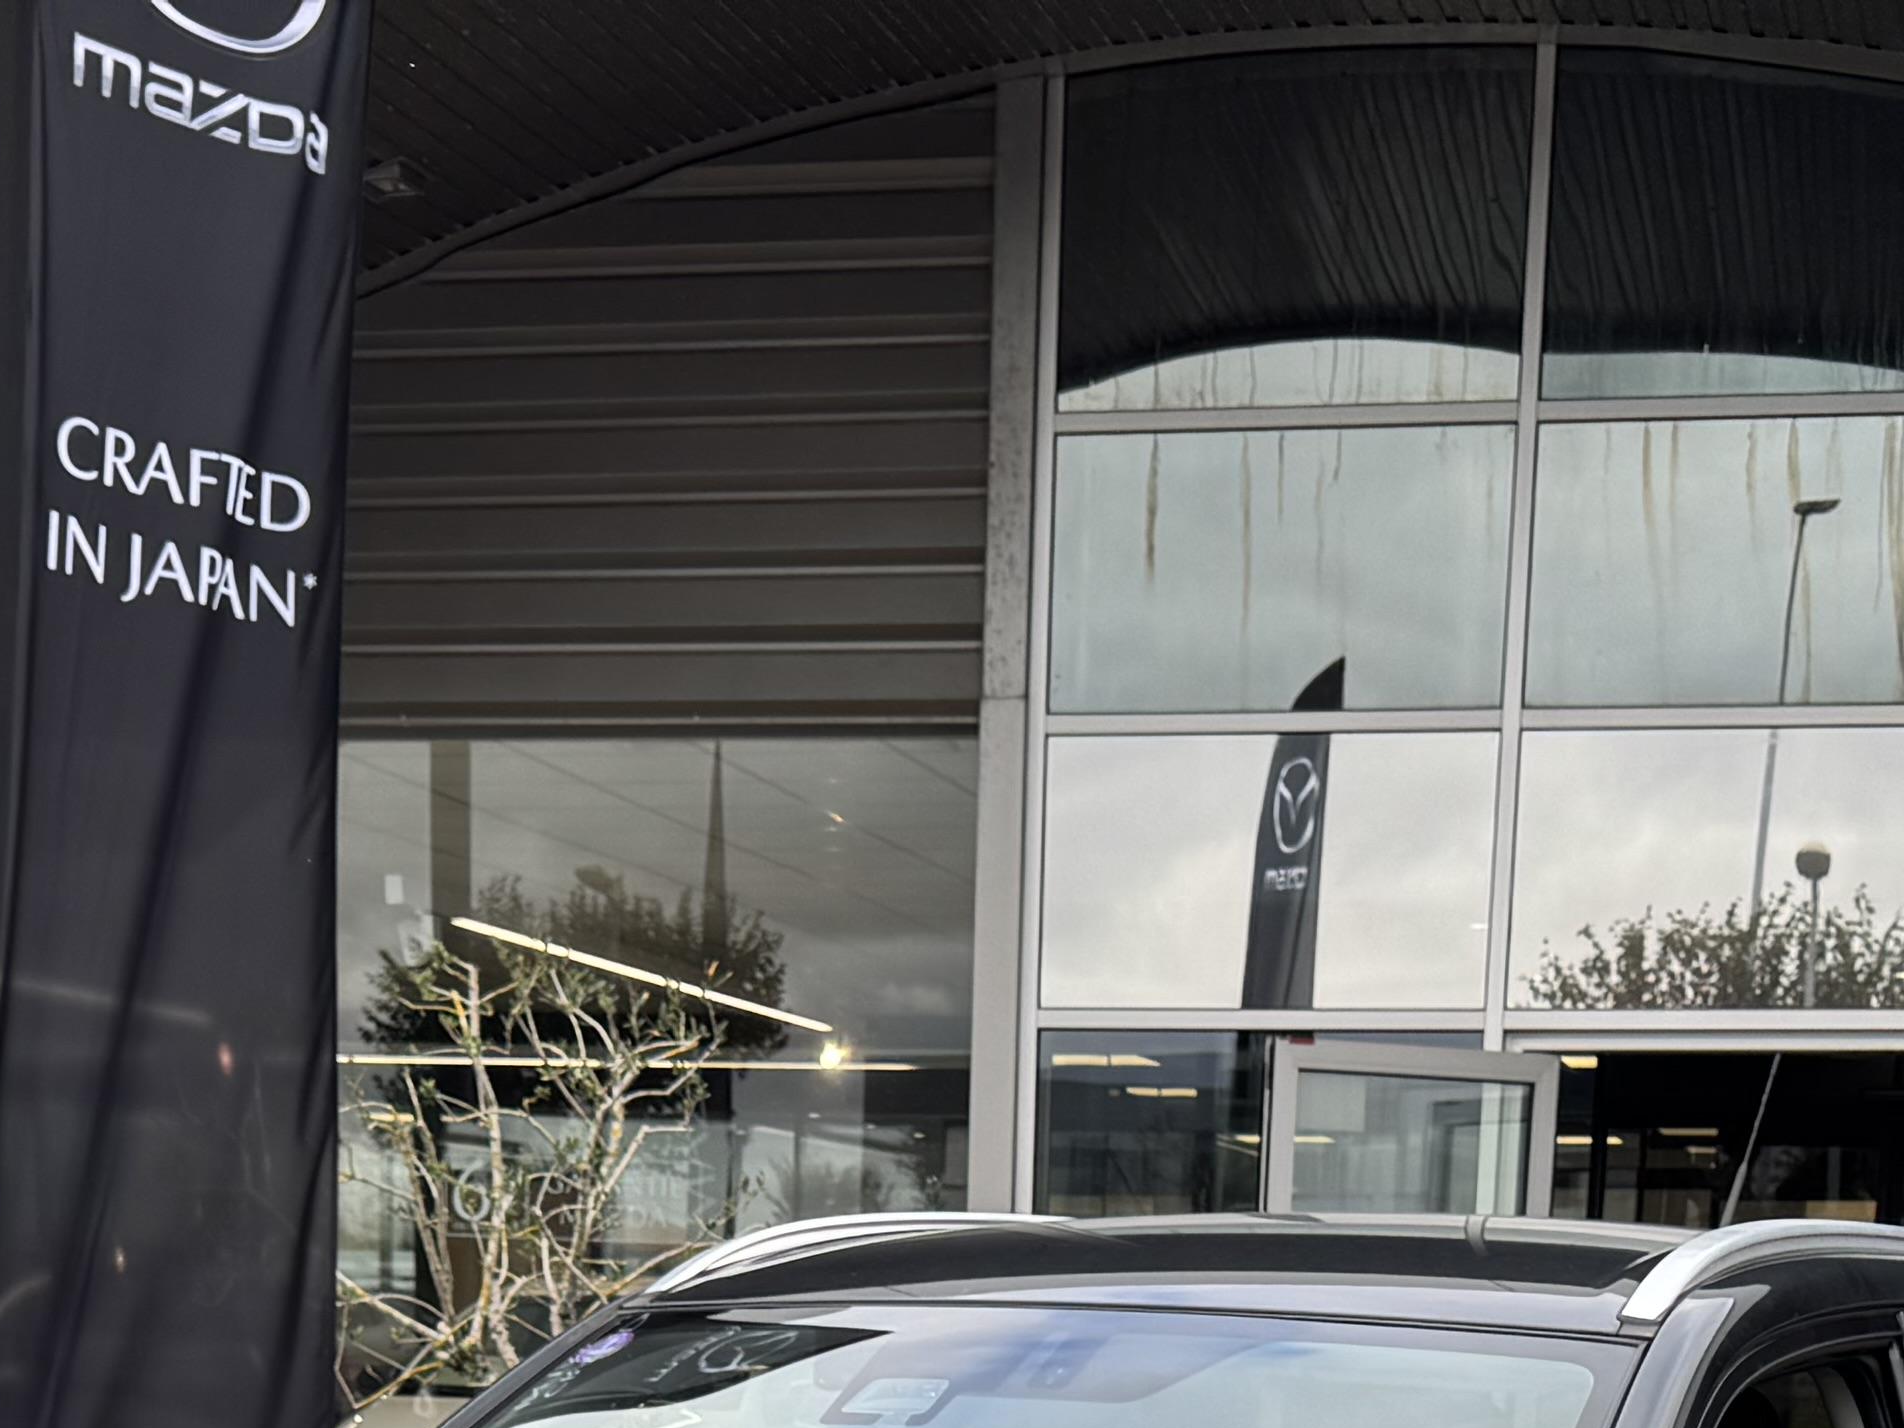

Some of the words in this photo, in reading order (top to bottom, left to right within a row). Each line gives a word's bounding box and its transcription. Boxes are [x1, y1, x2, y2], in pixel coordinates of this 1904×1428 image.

[72, 31, 329, 175] mazda
[56, 416, 312, 532] CRAFTED
[47, 508, 108, 585] IN
